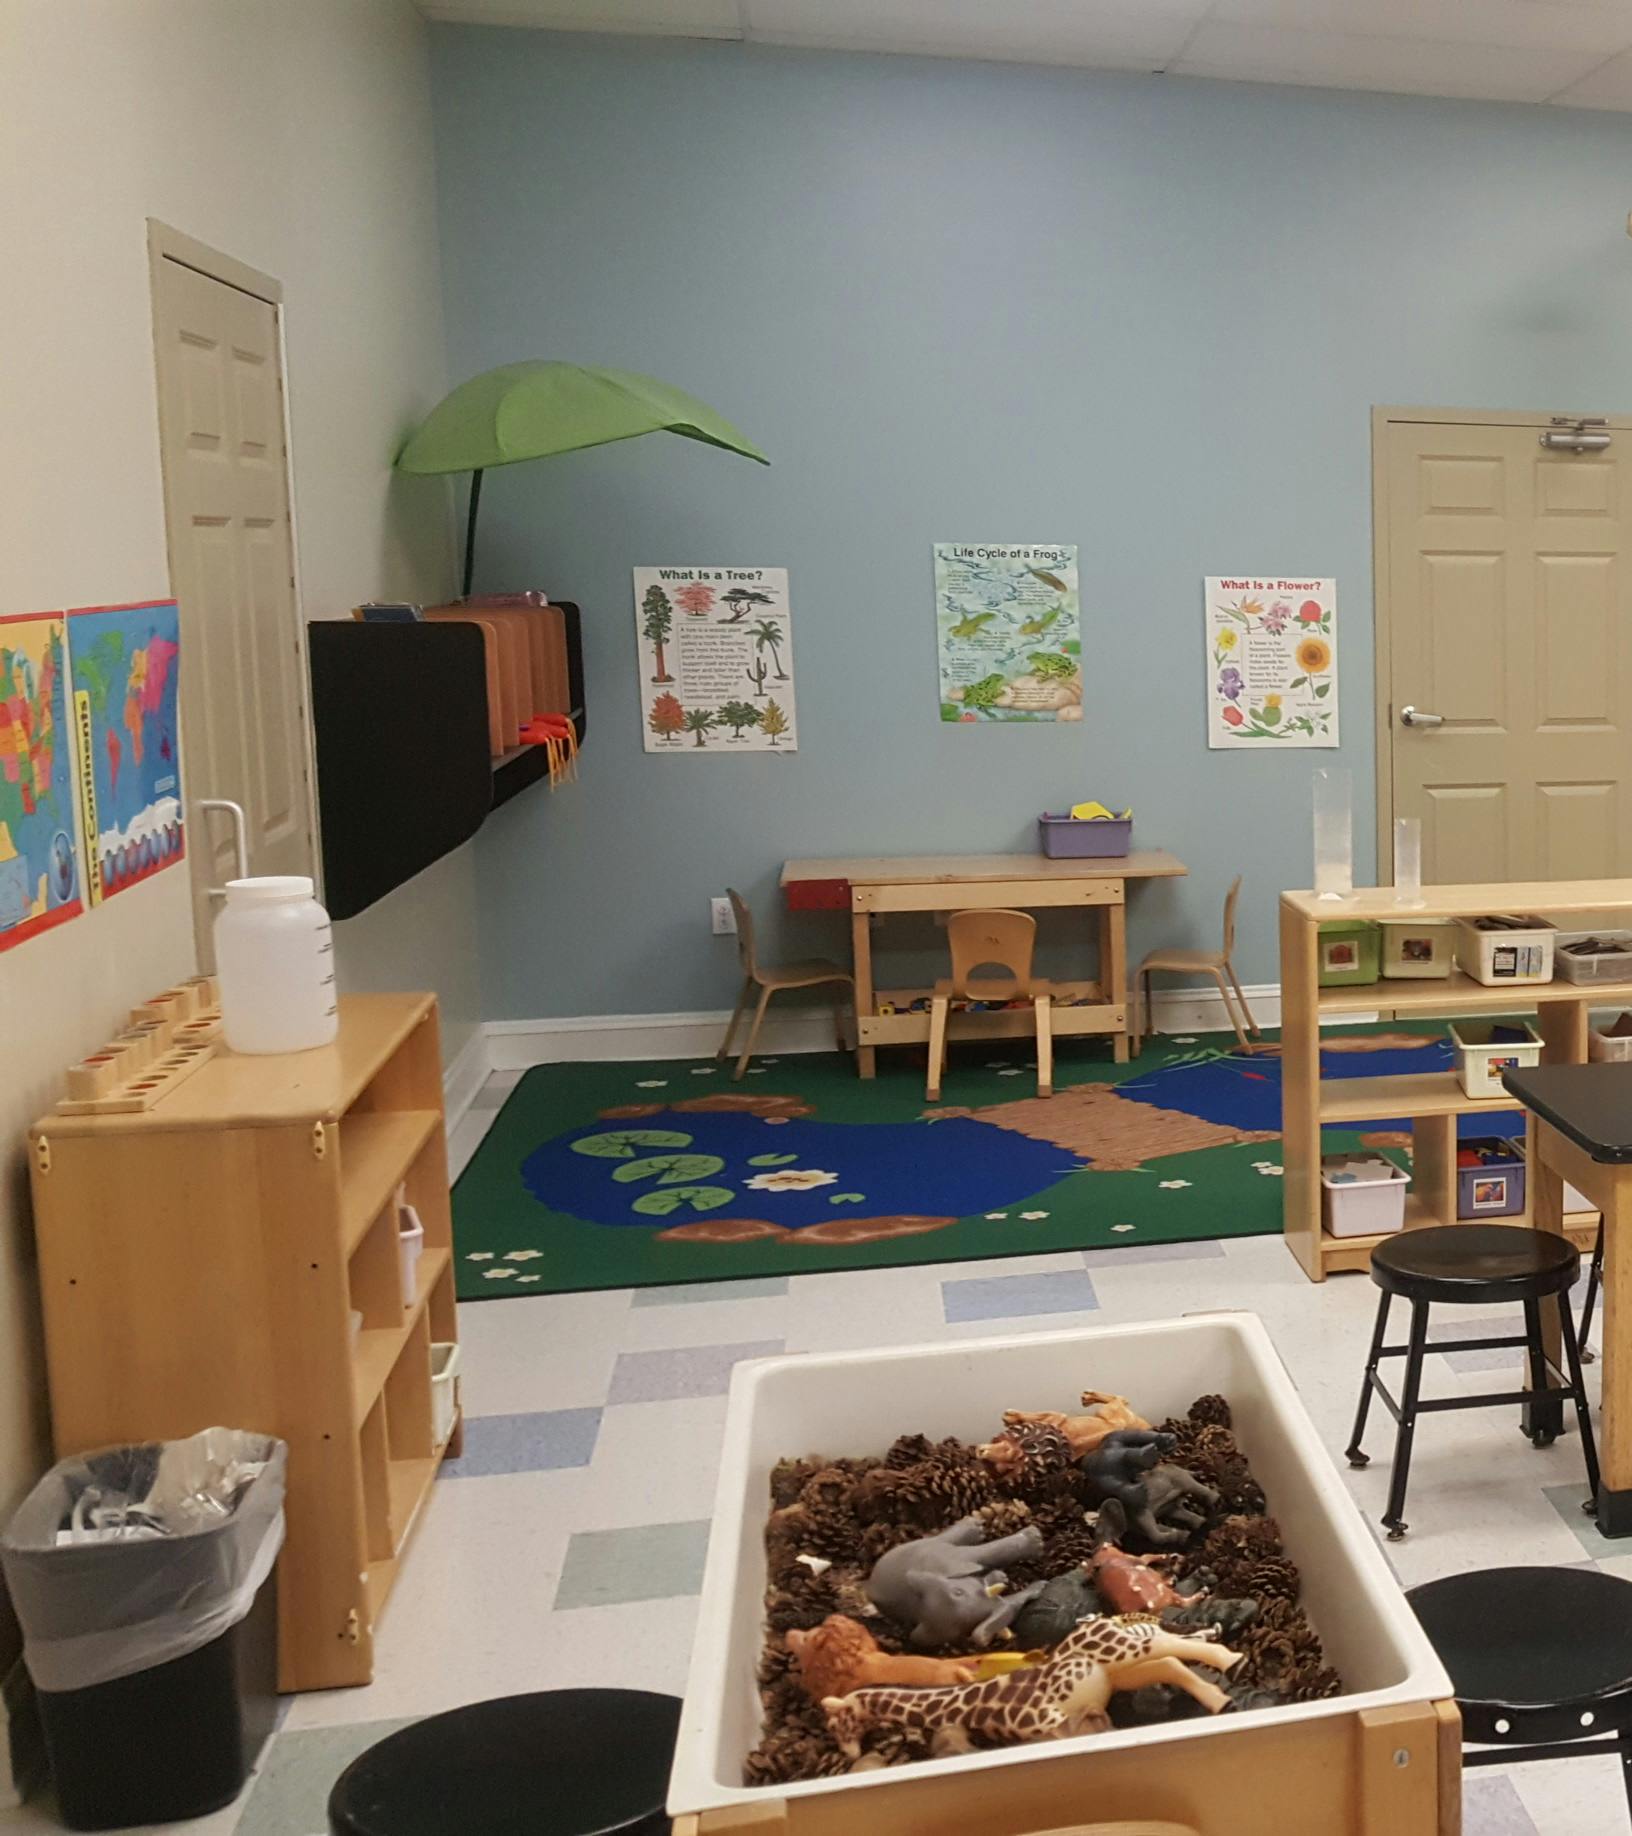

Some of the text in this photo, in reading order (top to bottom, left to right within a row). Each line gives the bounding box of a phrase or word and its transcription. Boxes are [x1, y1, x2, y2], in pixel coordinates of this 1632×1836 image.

[954, 547, 1058, 561] Life Cycle of a Frog
[659, 569, 763, 580] What Is a Tree?
[1220, 580, 1321, 591] What Is a Flower?
